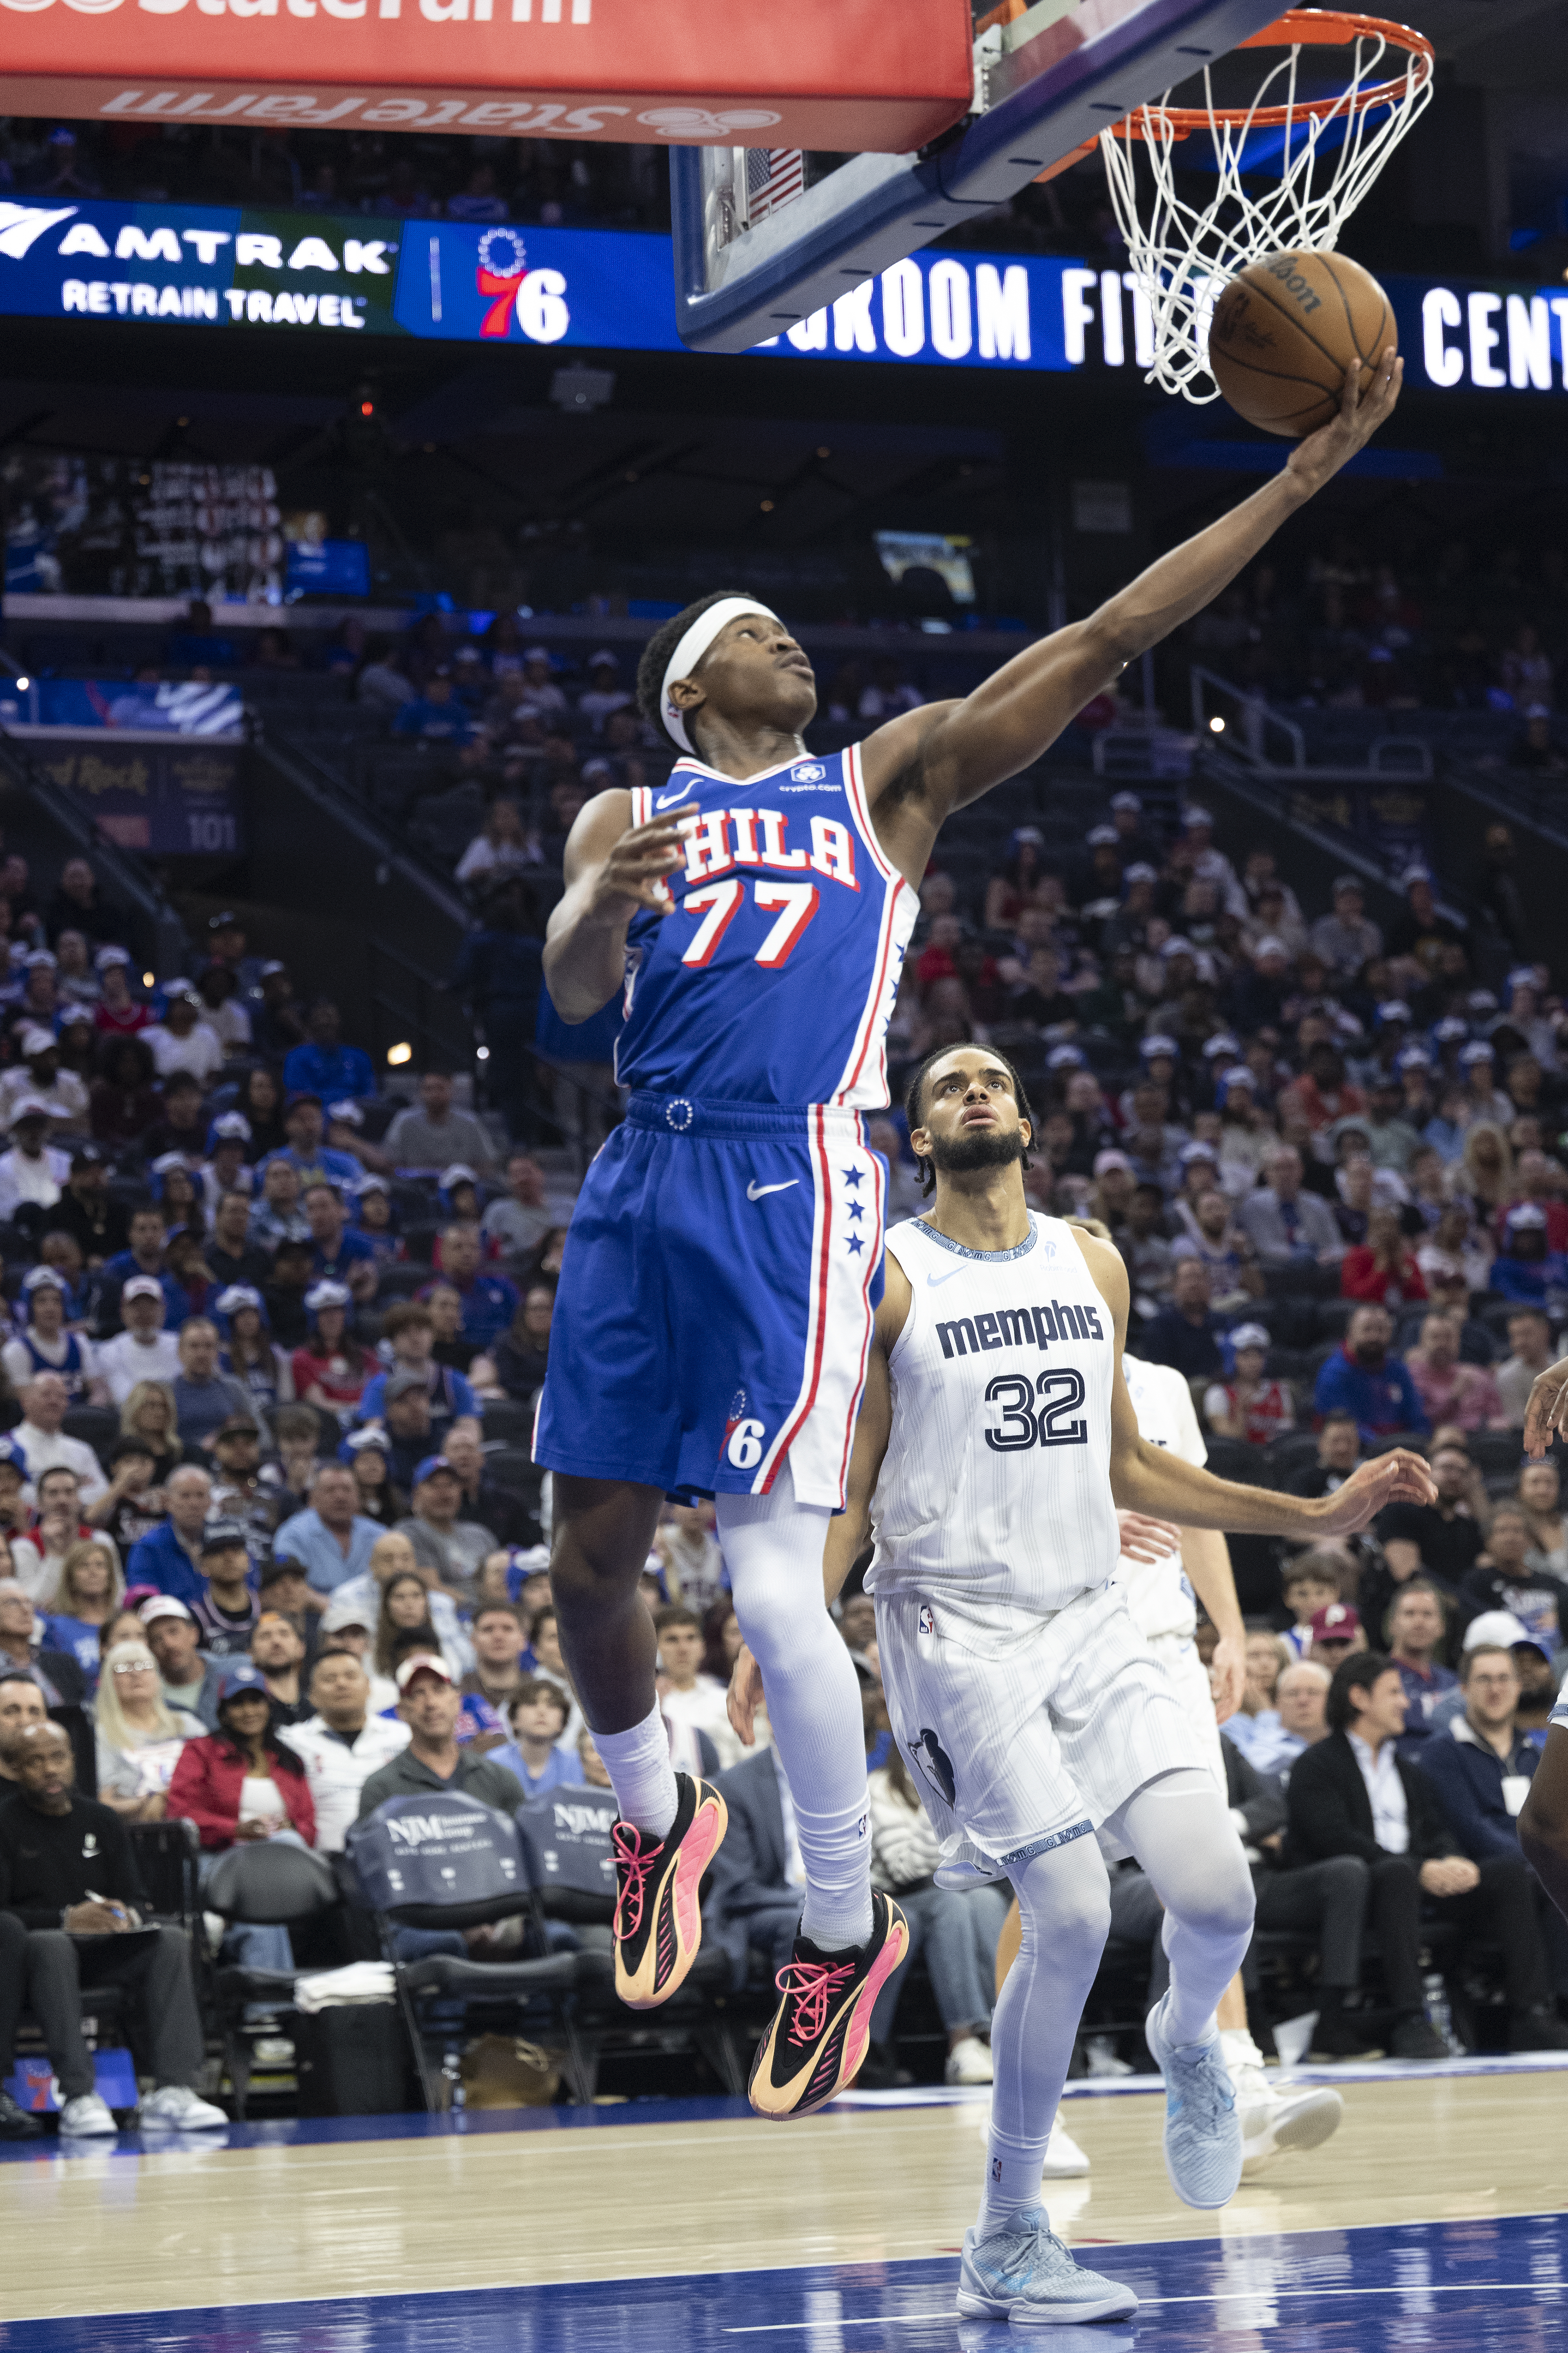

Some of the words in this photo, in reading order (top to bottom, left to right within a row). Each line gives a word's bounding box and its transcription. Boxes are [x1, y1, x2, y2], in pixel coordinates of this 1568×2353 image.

[57, 223, 391, 274] AMTRAK
[62, 280, 218, 320] RETRAIN
[225, 288, 365, 328] TRAVEL
[751, 259, 1031, 360] ROOM
[779, 784, 842, 793] crypto.com
[652, 808, 860, 902] HILA
[681, 879, 821, 968] 77
[935, 1299, 1104, 1359] memphis
[985, 1368, 1088, 1453] 32
[386, 1815, 443, 1846] NJM
